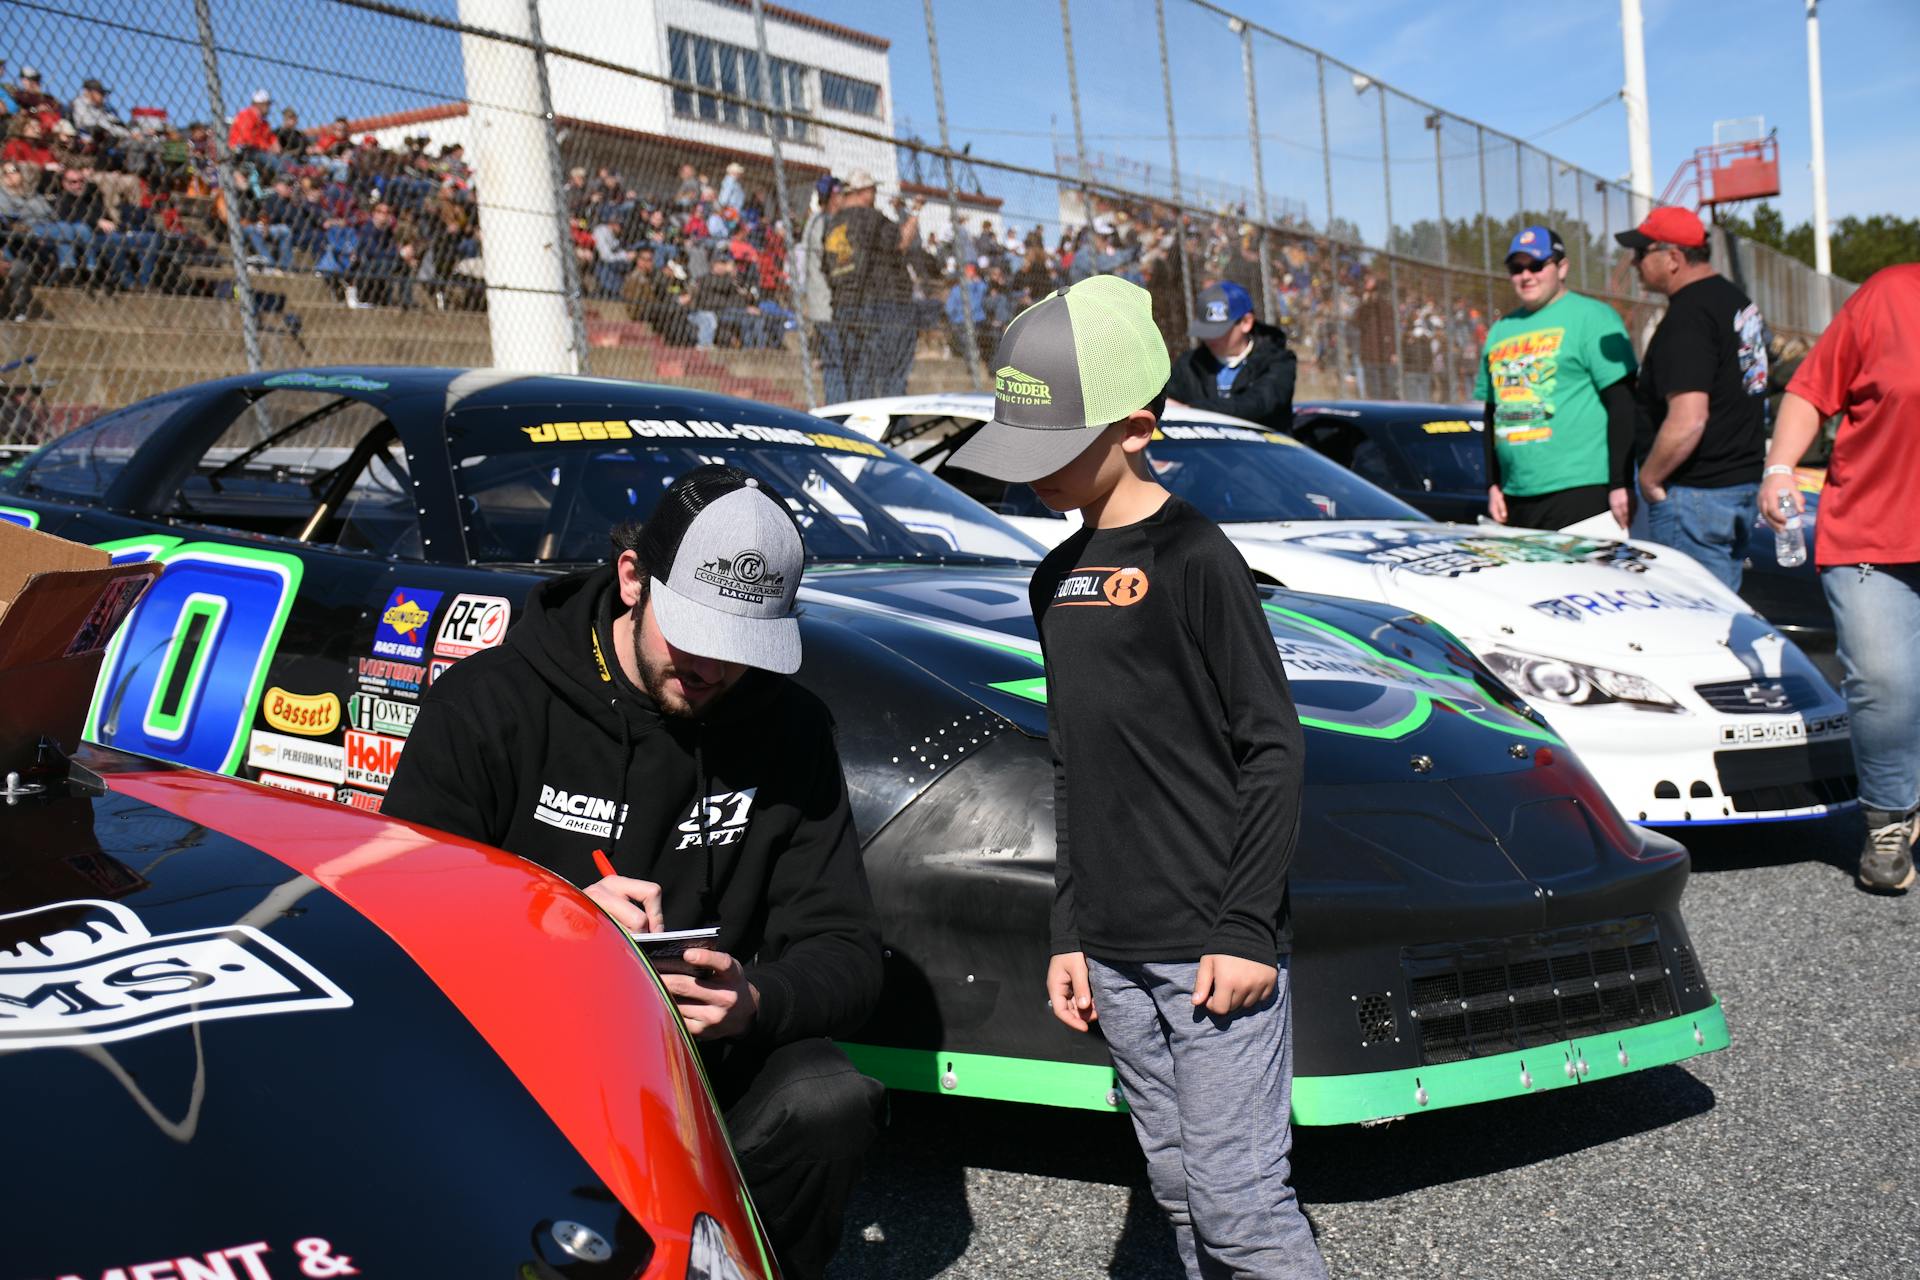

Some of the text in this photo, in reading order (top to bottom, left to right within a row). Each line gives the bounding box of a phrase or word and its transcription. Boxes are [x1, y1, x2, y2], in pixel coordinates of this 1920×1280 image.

[1006, 380, 1052, 399] YODER
[521, 420, 633, 442] JEGS
[628, 419, 695, 438] CRA
[700, 572, 751, 592] COLTMAN
[721, 588, 762, 602] RACING
[373, 640, 398, 655] RACE
[396, 643, 424, 659] FUELS
[359, 657, 427, 684] VICTORY
[273, 695, 332, 726] Bassett
[282, 748, 343, 772] PERFORMANCE
[347, 768, 393, 786] HP CAR
[678, 786, 759, 832] 51
[293, 1237, 360, 1279] &
